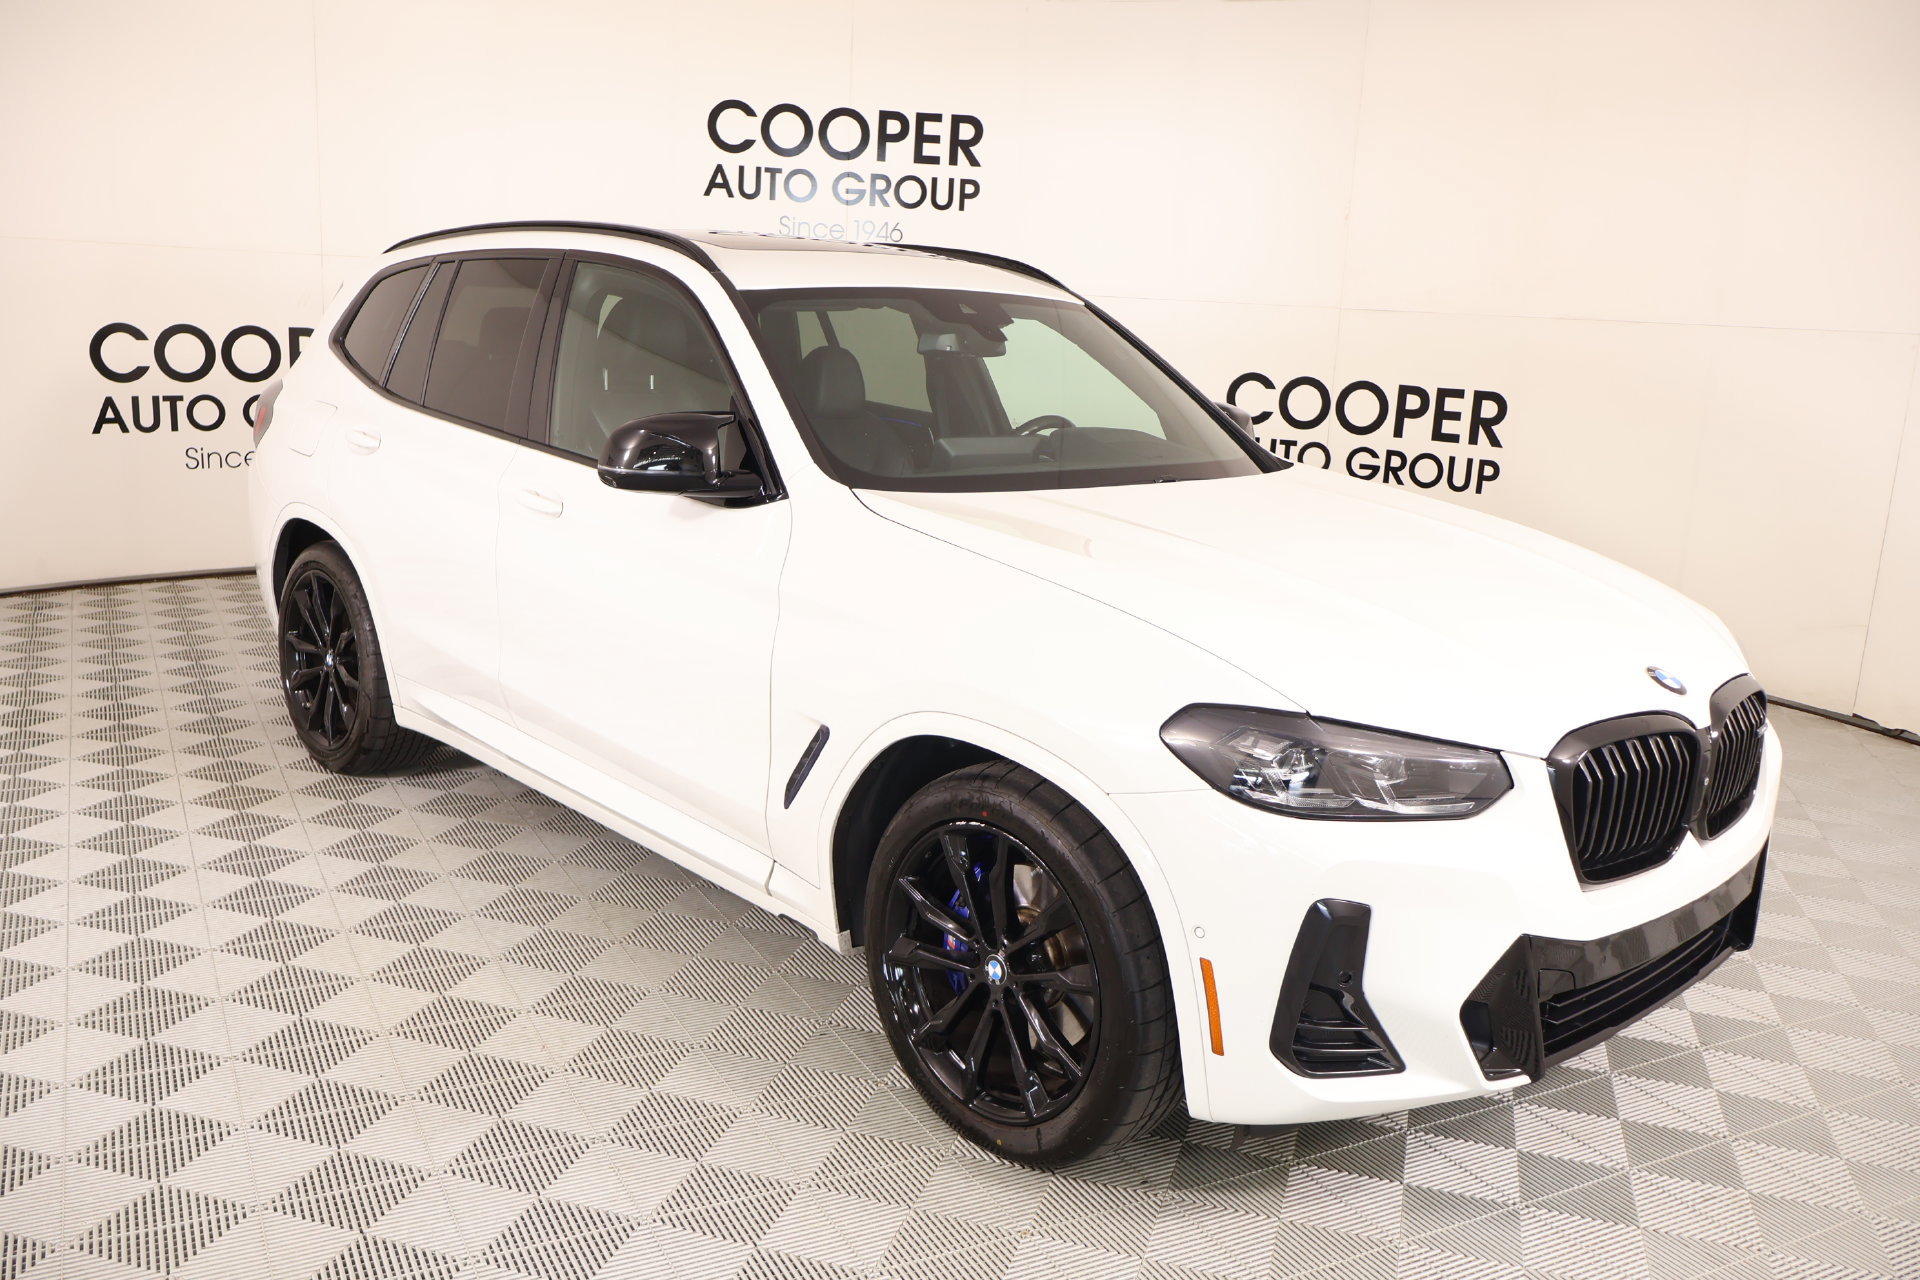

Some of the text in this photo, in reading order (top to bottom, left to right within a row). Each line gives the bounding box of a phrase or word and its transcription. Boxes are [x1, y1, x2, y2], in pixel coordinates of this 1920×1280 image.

[707, 99, 984, 167] COOPER
[703, 163, 981, 211] AUTO GROUP
[778, 215, 904, 242] Since 1946
[92, 394, 226, 434] AUTO
[1226, 372, 1508, 448] COOPER
[1346, 446, 1500, 495] GROUP
